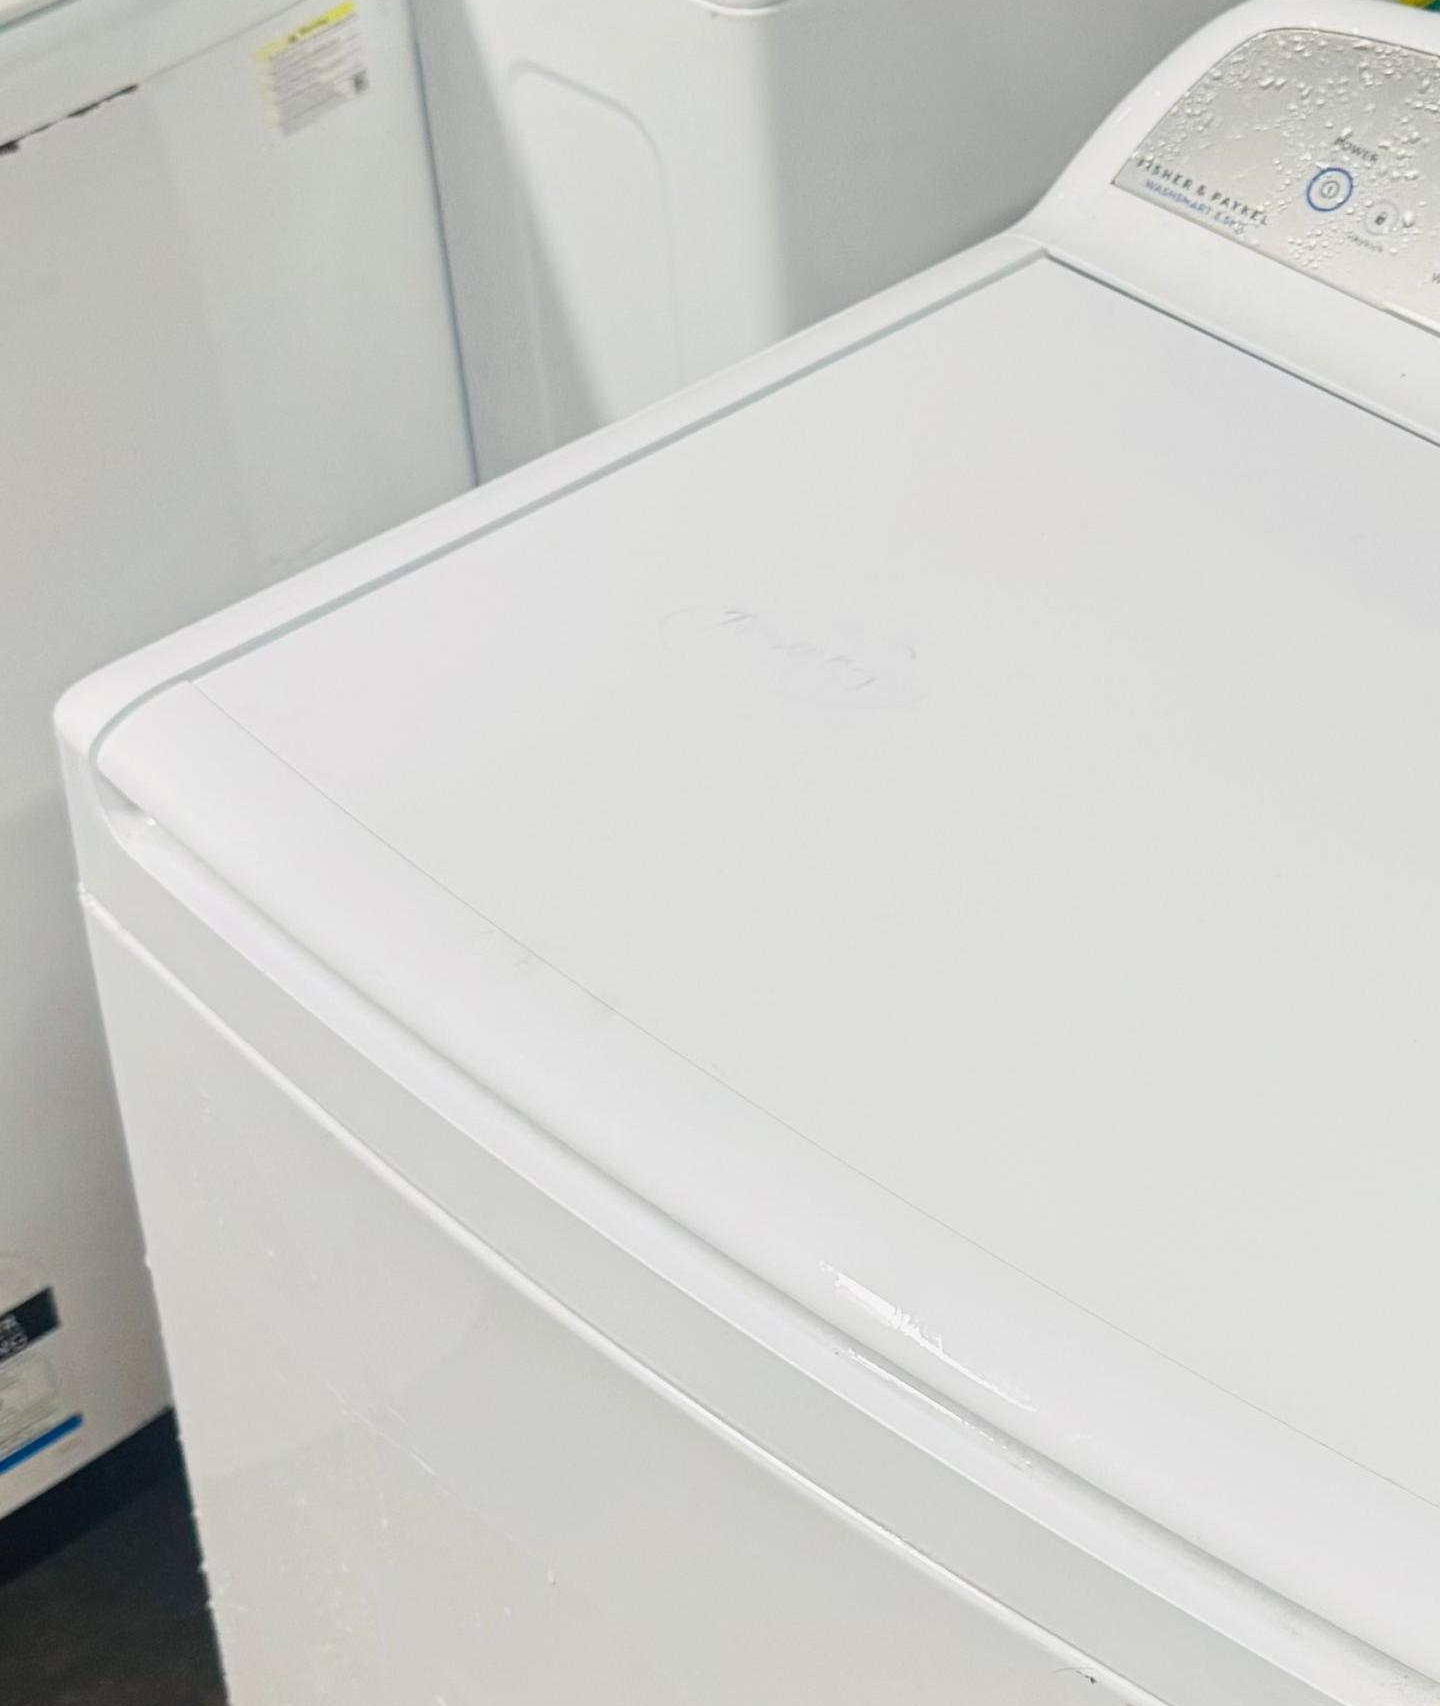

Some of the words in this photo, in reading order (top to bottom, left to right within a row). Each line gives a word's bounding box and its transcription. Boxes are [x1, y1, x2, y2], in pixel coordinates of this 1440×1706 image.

[1334, 135, 1379, 163] POWER
[1137, 158, 1193, 189] FISHER
[1196, 184, 1207, 196] &
[1211, 192, 1268, 225] PAYKEL
